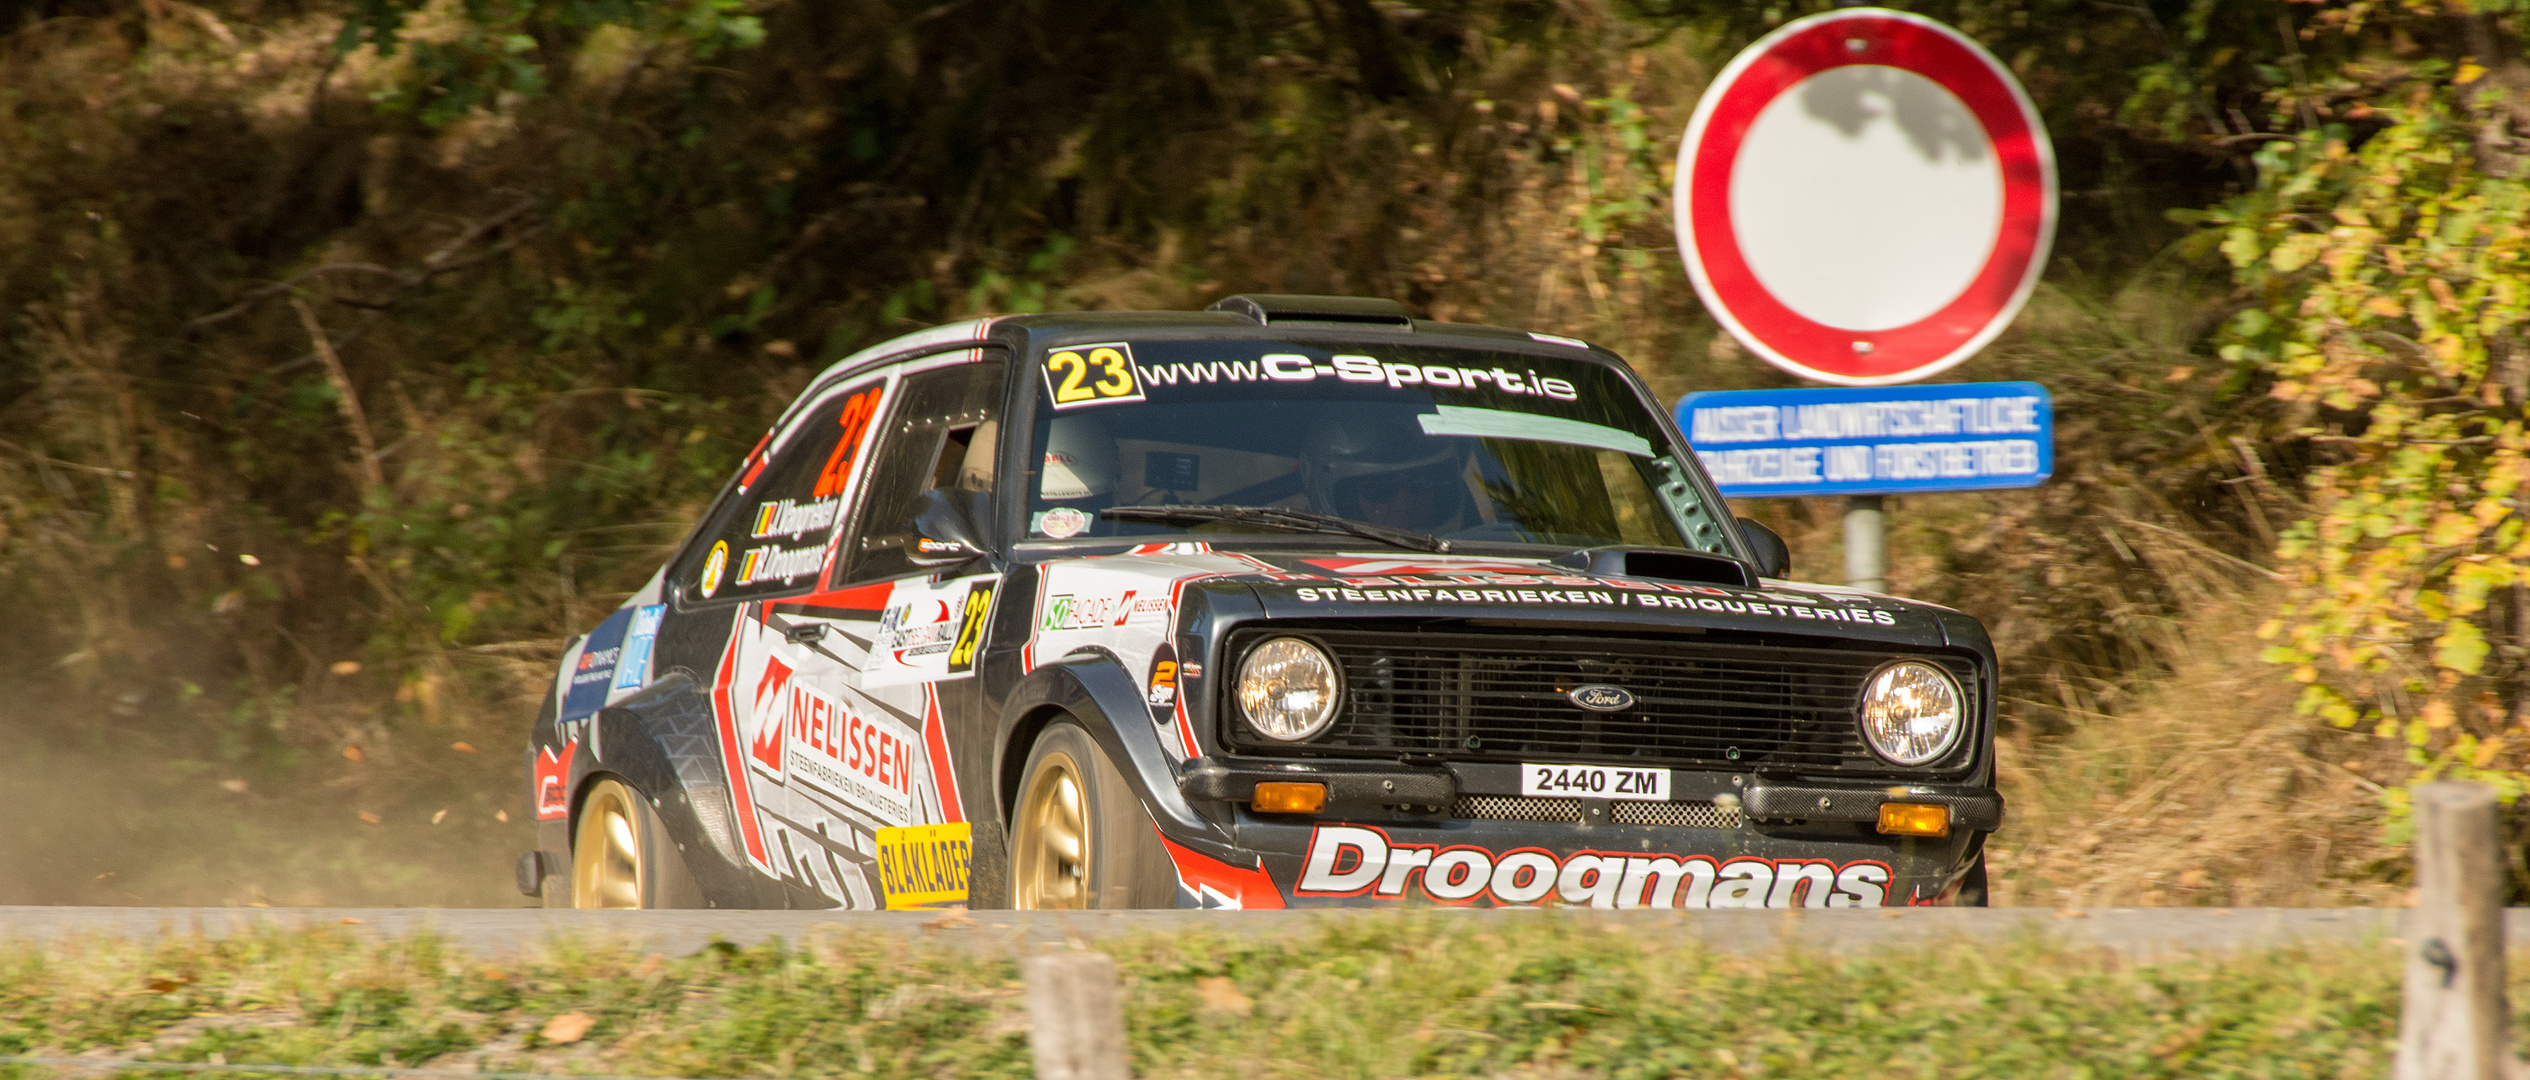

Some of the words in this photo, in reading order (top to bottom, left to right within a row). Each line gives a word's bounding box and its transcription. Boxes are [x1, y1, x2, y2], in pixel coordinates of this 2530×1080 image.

[1048, 347, 1134, 402] 23
[1138, 353, 1578, 400] www.C-Sport.ie
[813, 387, 882, 498] 23
[950, 589, 992, 665] 23
[1296, 587, 1614, 606] STEENFABRIEKEN
[1635, 593, 1897, 626] BRIQUETERIES
[1585, 689, 1621, 705] Ford
[791, 685, 911, 795] NELISSEN
[856, 782, 909, 824] BRIQUETERIES
[1536, 768, 1606, 793] 2440
[1615, 771, 1657, 795] ZM
